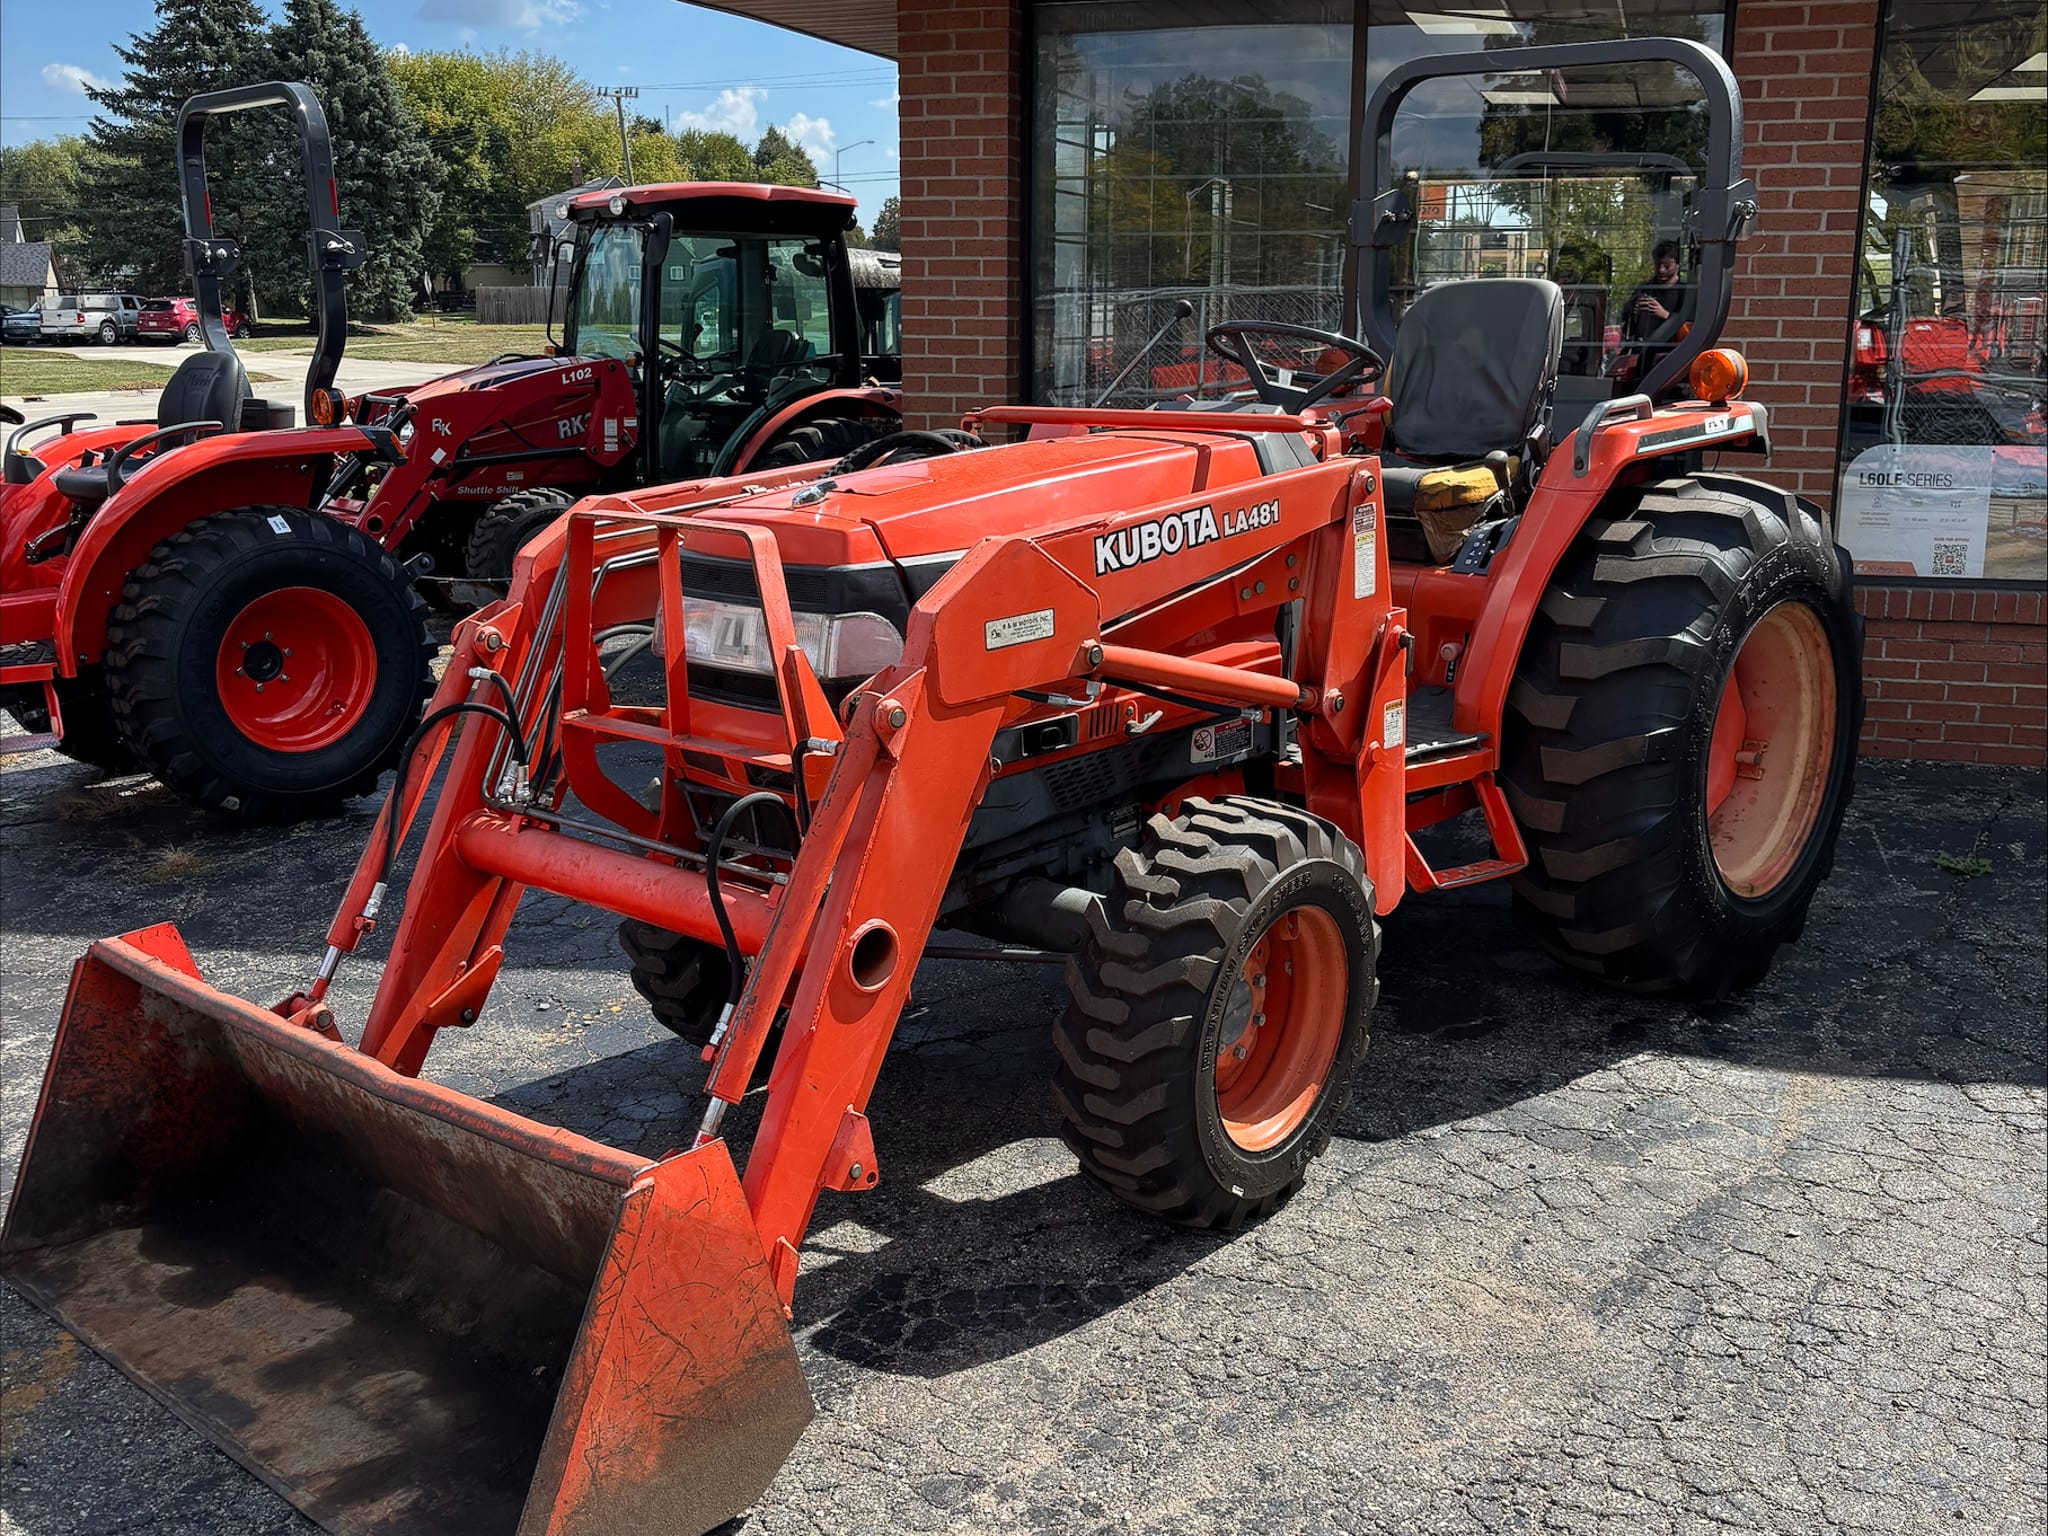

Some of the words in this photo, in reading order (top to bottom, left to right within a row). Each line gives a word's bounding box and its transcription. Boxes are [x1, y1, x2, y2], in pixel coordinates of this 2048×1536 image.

[561, 367, 593, 385] L102
[432, 418, 452, 436] RK
[1906, 472, 1953, 488] SERIES
[457, 486, 494, 495] Shuttle
[1095, 505, 1219, 577] KUBOTA
[1223, 499, 1281, 537] LA481
[1270, 871, 1312, 910] STEER
